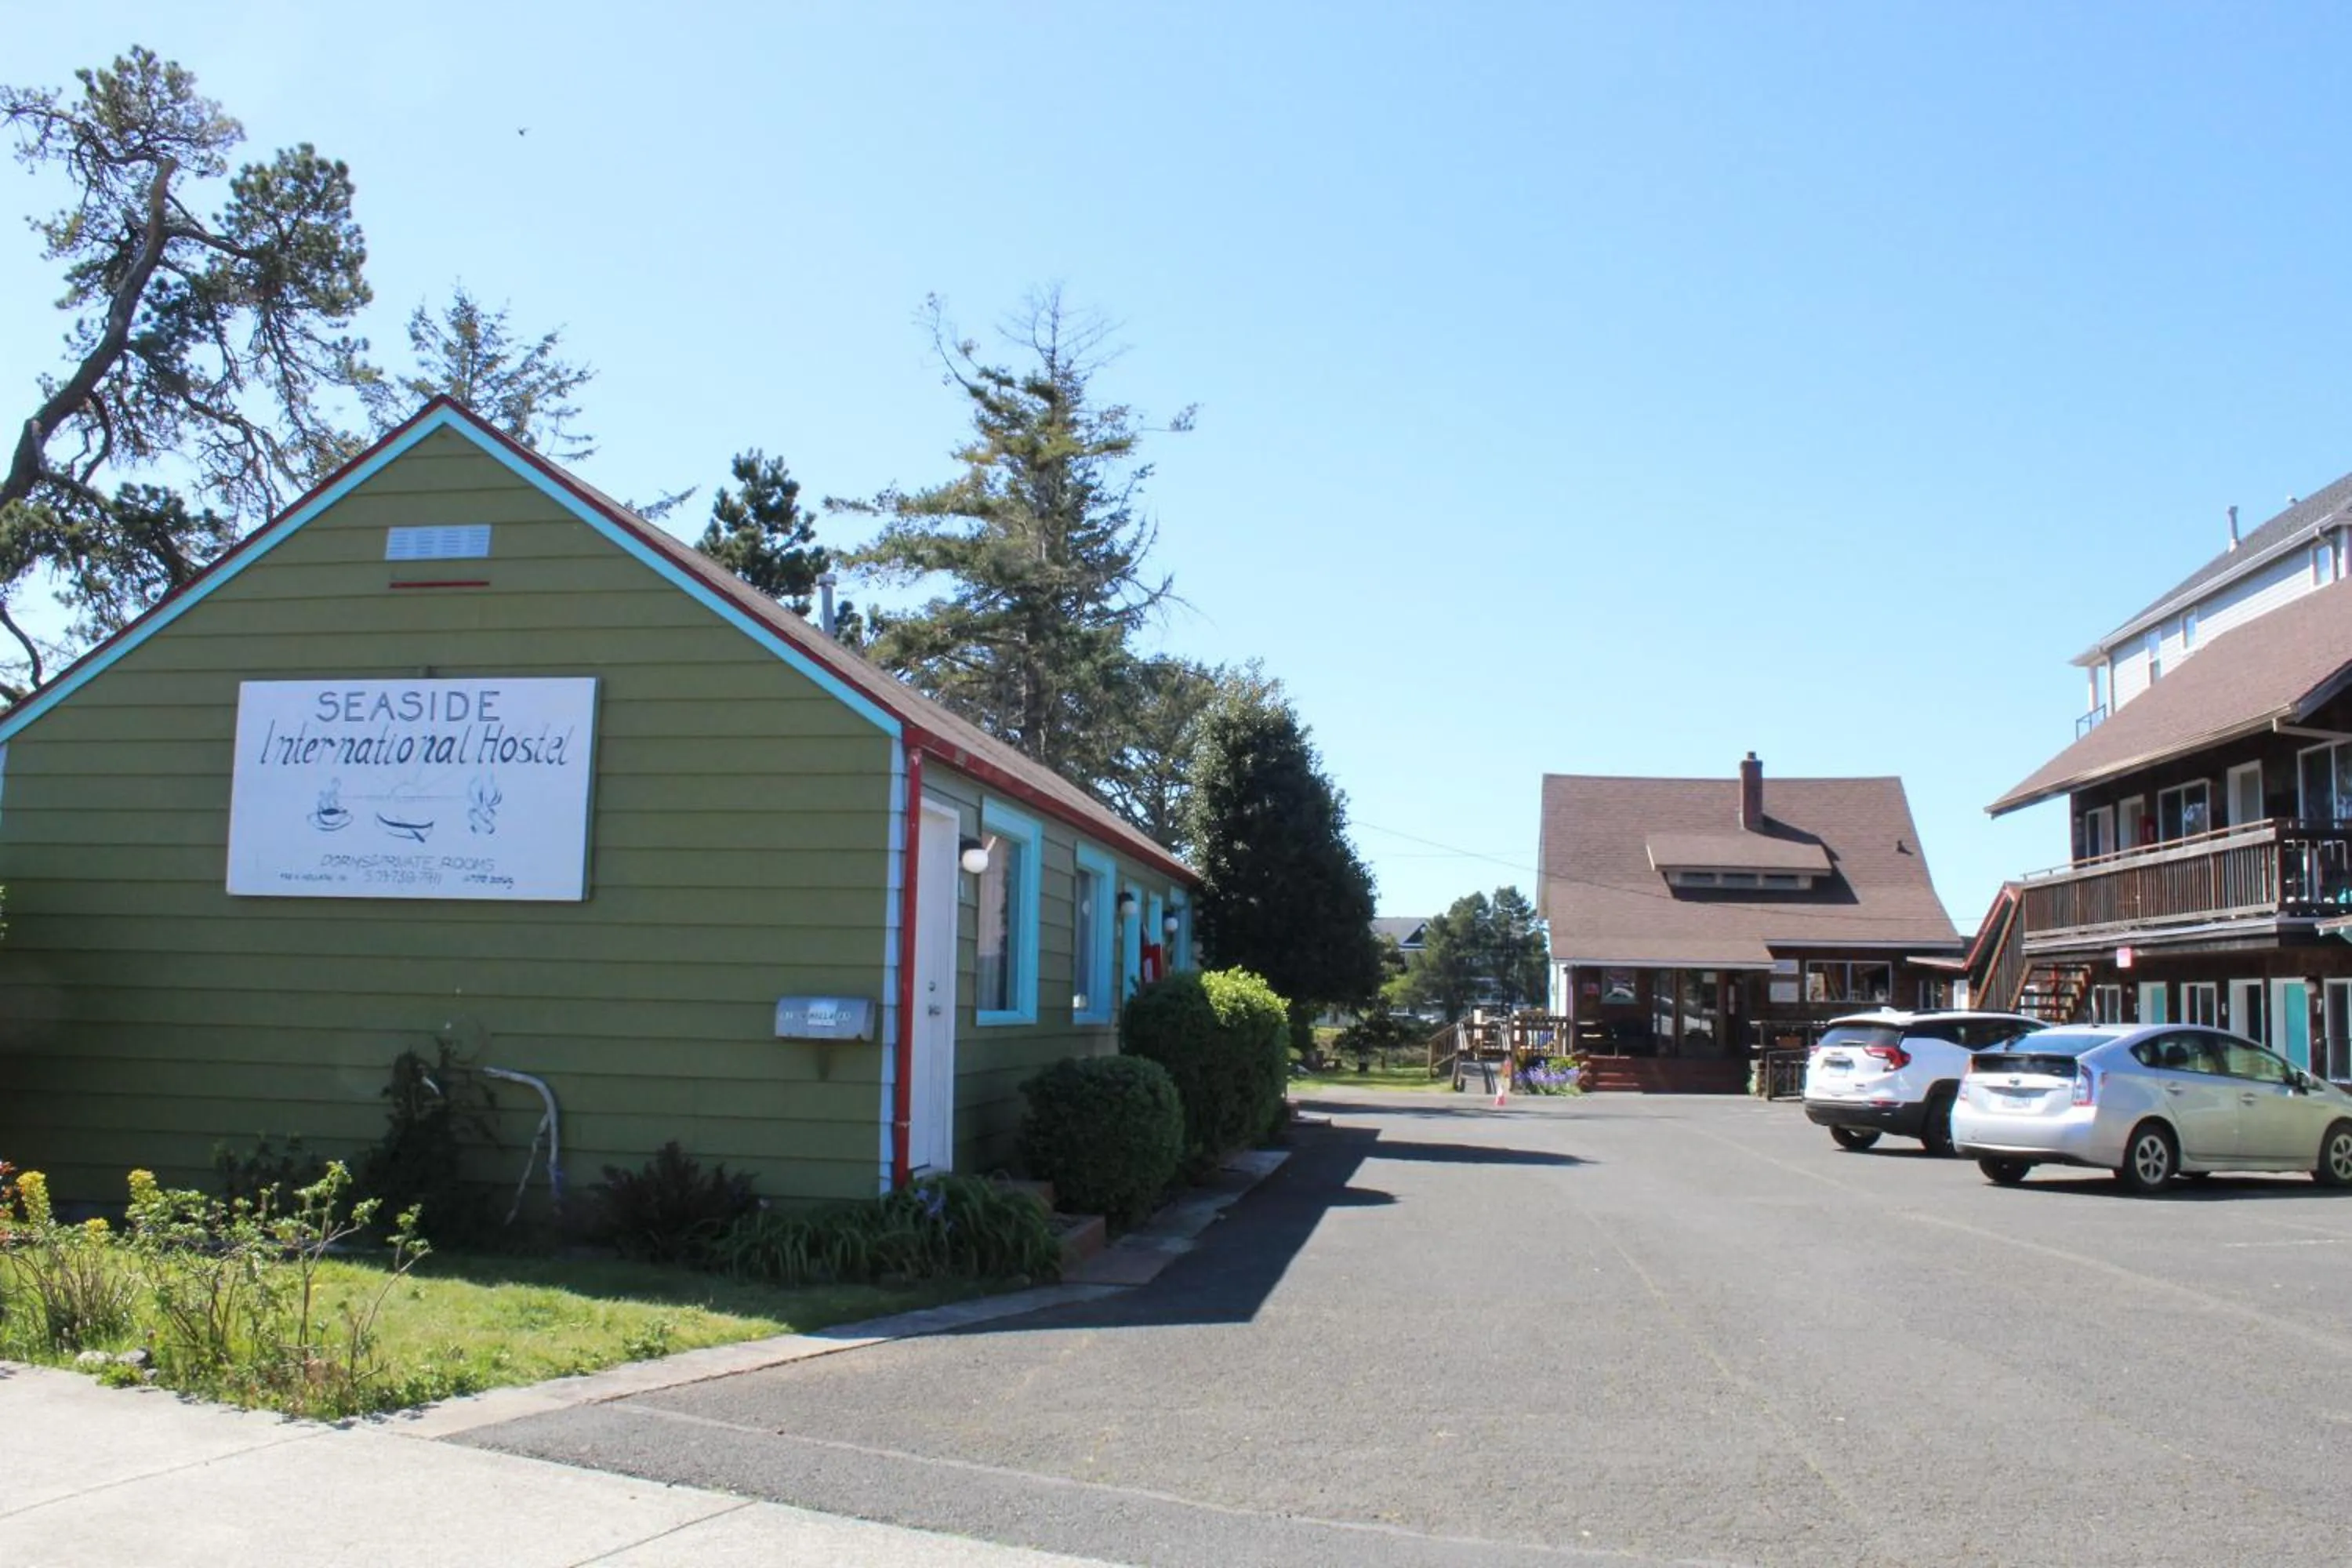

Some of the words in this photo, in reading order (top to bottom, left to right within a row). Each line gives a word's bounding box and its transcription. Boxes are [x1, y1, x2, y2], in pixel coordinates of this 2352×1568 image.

[315, 691, 501, 722] SEASIDE
[260, 719, 473, 766] International
[476, 722, 575, 766] Hostel
[441, 856, 495, 872] ROOMS
